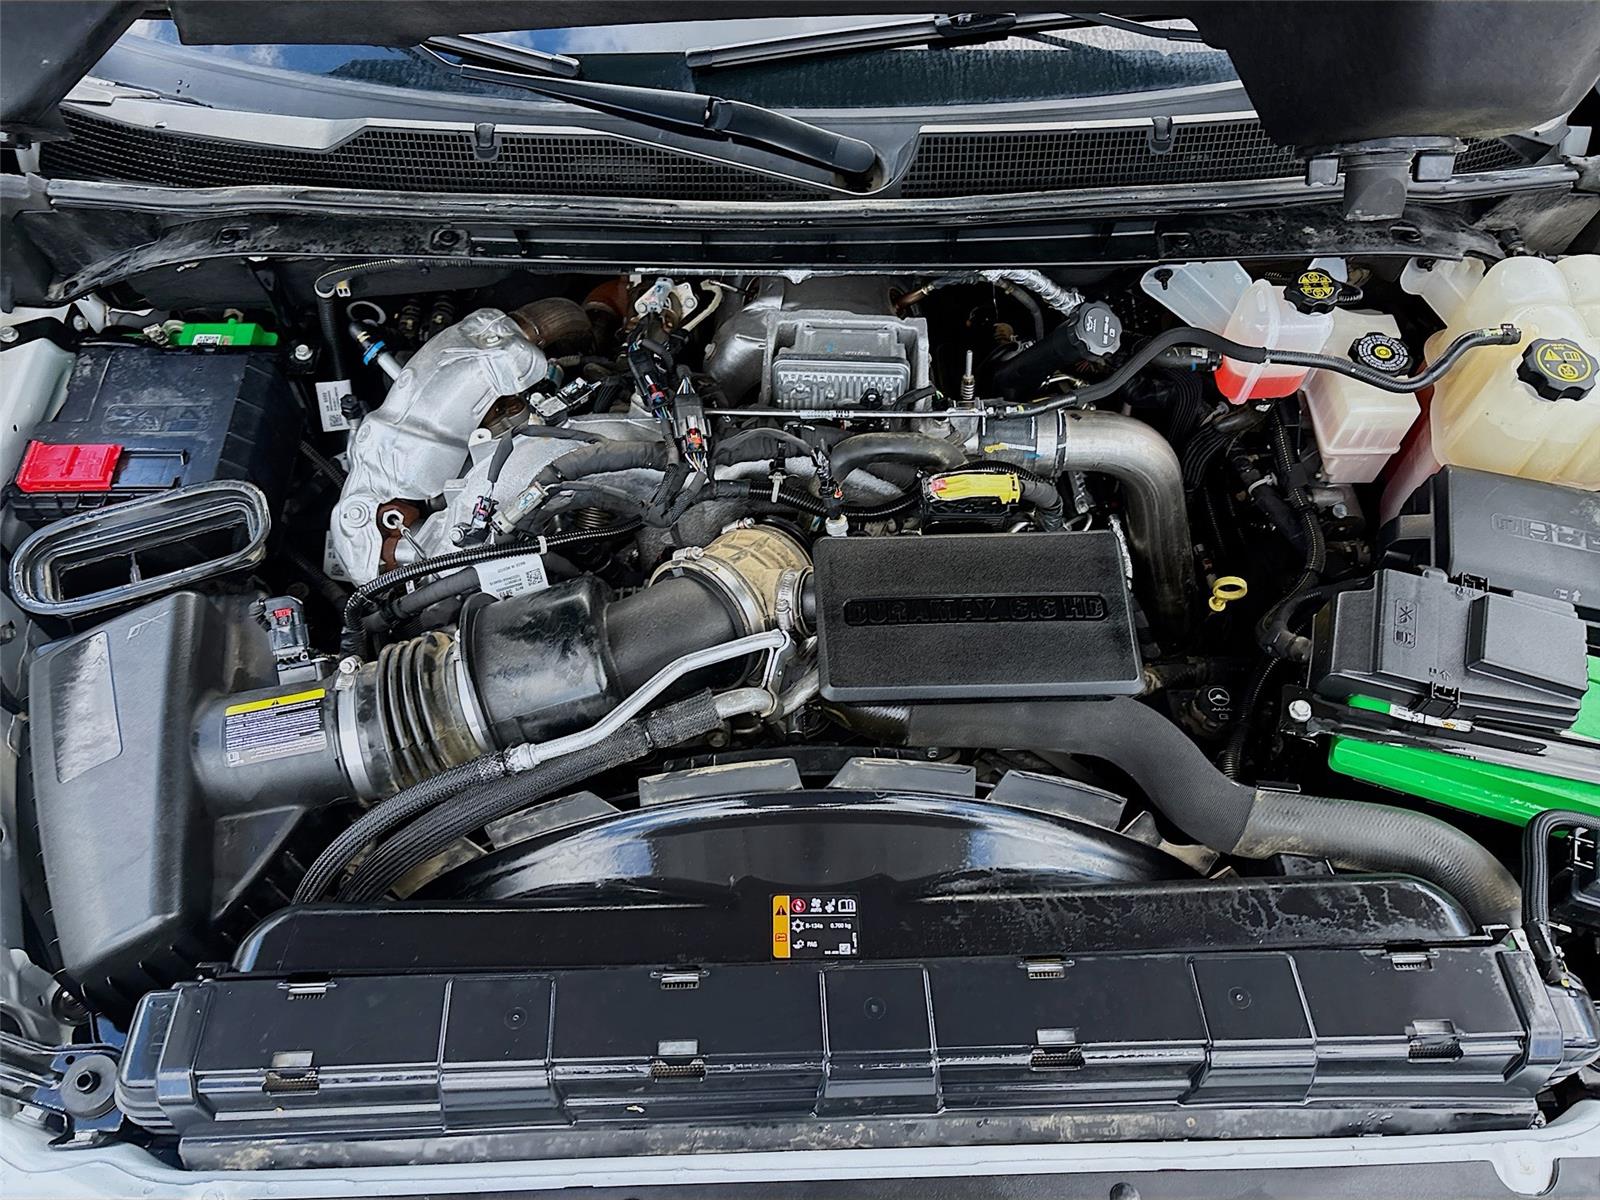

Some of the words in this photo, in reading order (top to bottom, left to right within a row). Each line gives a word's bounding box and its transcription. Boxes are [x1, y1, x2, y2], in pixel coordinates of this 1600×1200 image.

[847, 598, 1000, 624] DURAMAX
[1010, 597, 1057, 620] 6.6
[1063, 596, 1105, 619] HD
[806, 940, 818, 948] PAG
